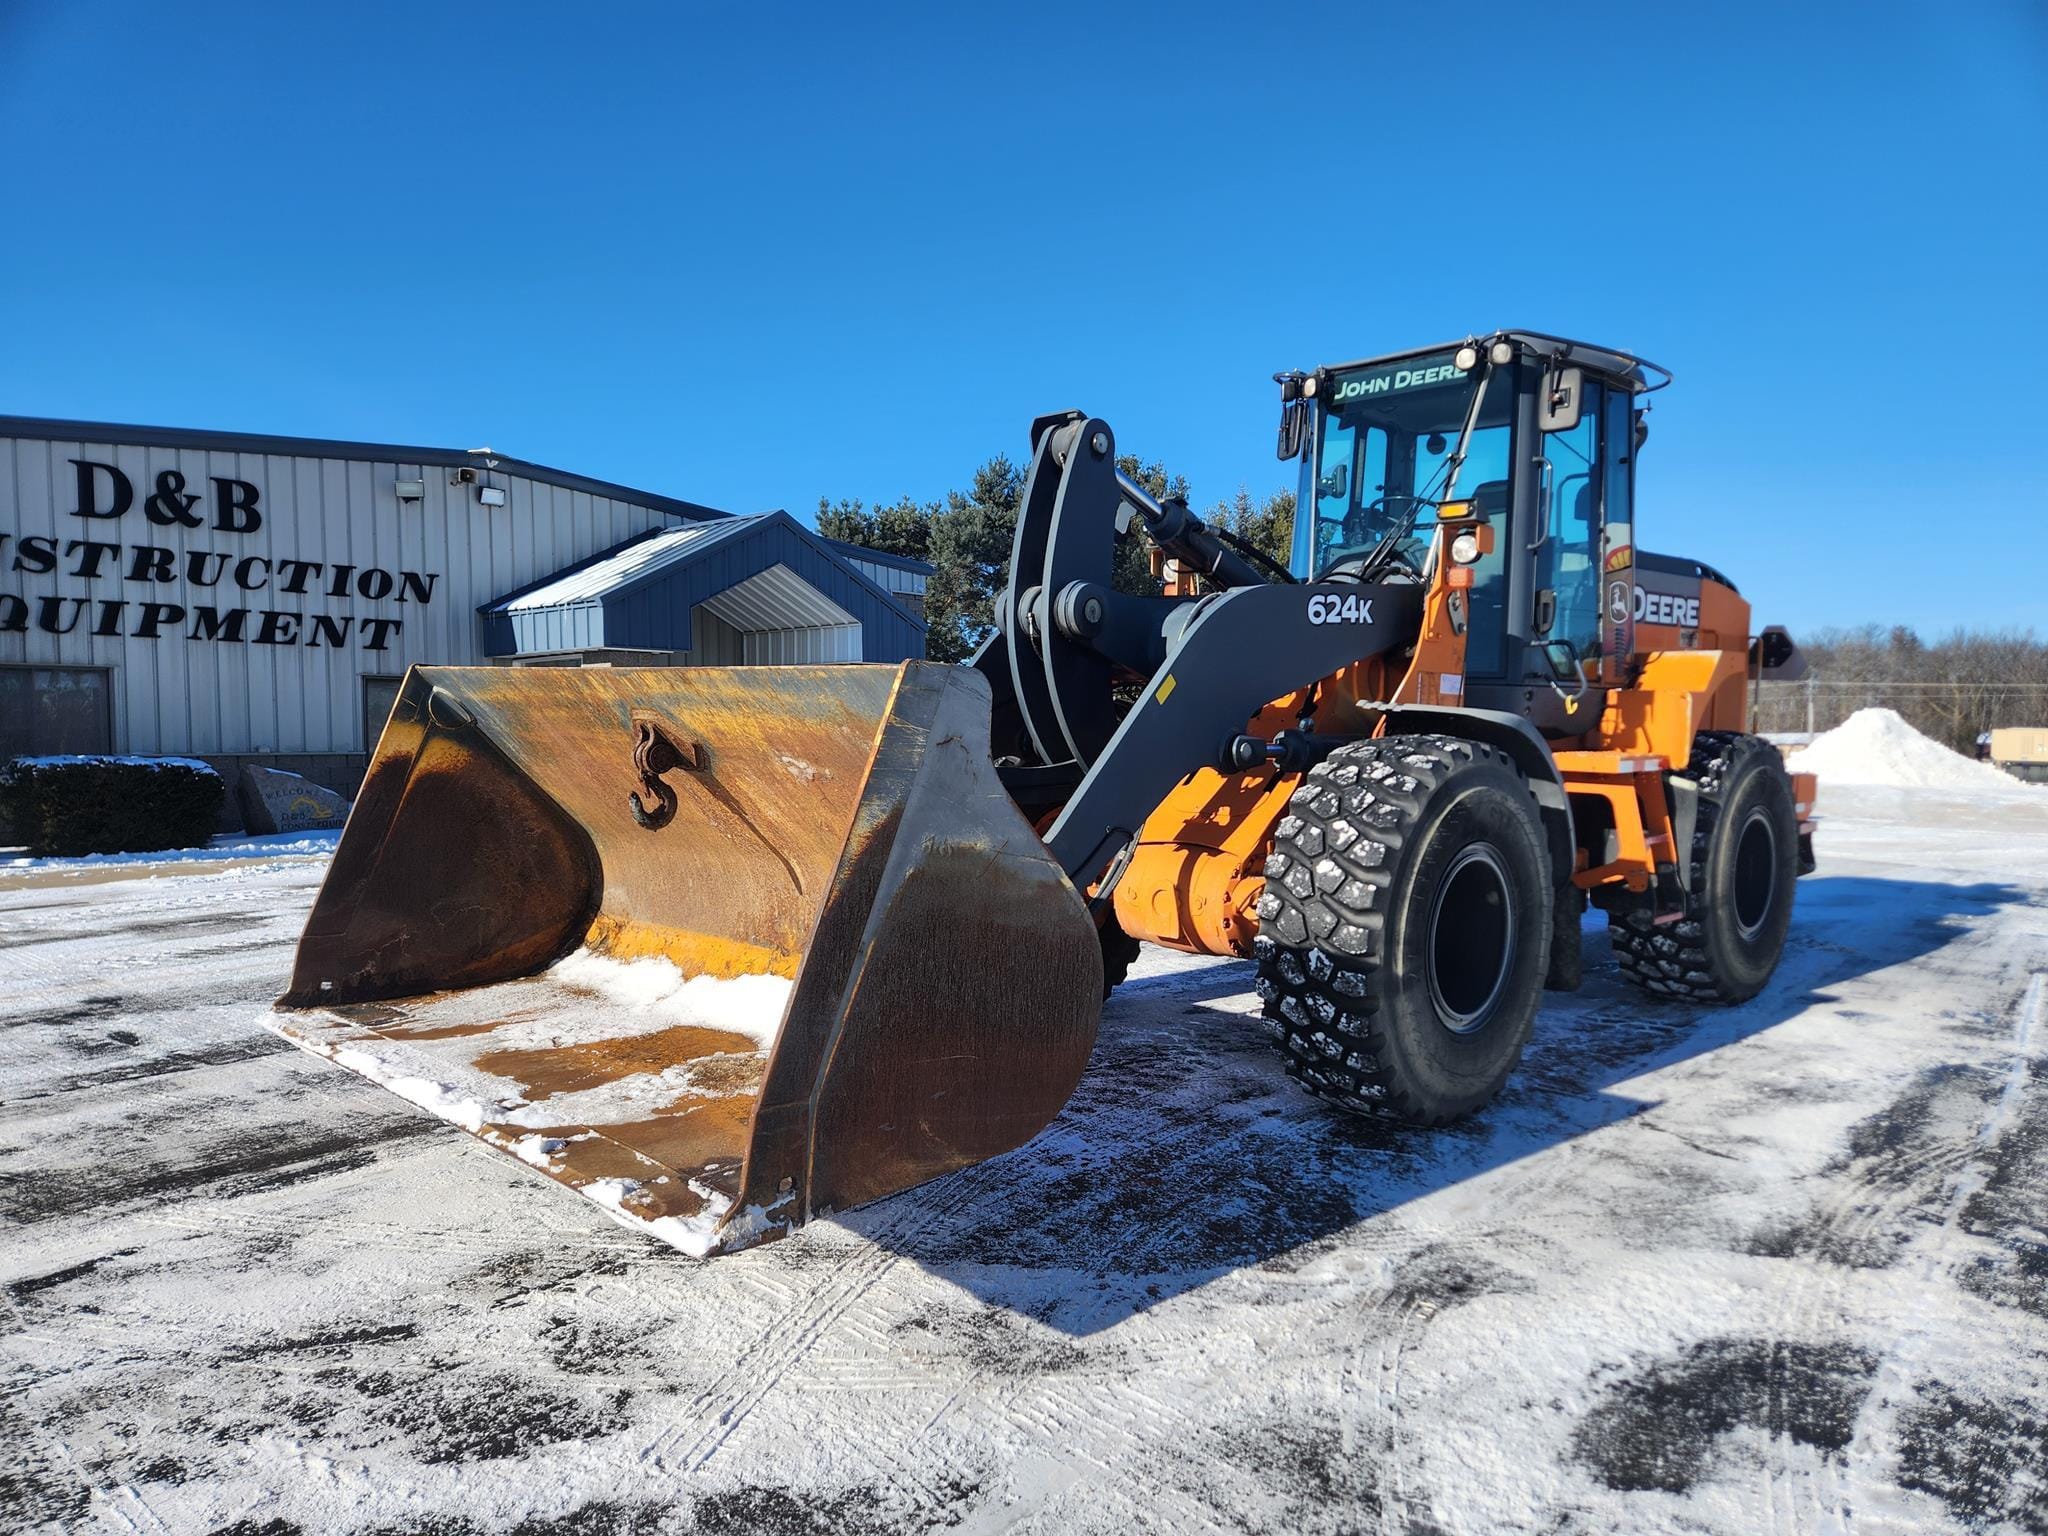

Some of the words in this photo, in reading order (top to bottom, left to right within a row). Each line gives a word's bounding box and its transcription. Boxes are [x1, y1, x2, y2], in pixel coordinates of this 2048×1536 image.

[1334, 375, 1391, 400] JOHN
[68, 458, 262, 533] D&B
[0, 533, 439, 604] STRUCTION
[1307, 594, 1374, 625] 624K
